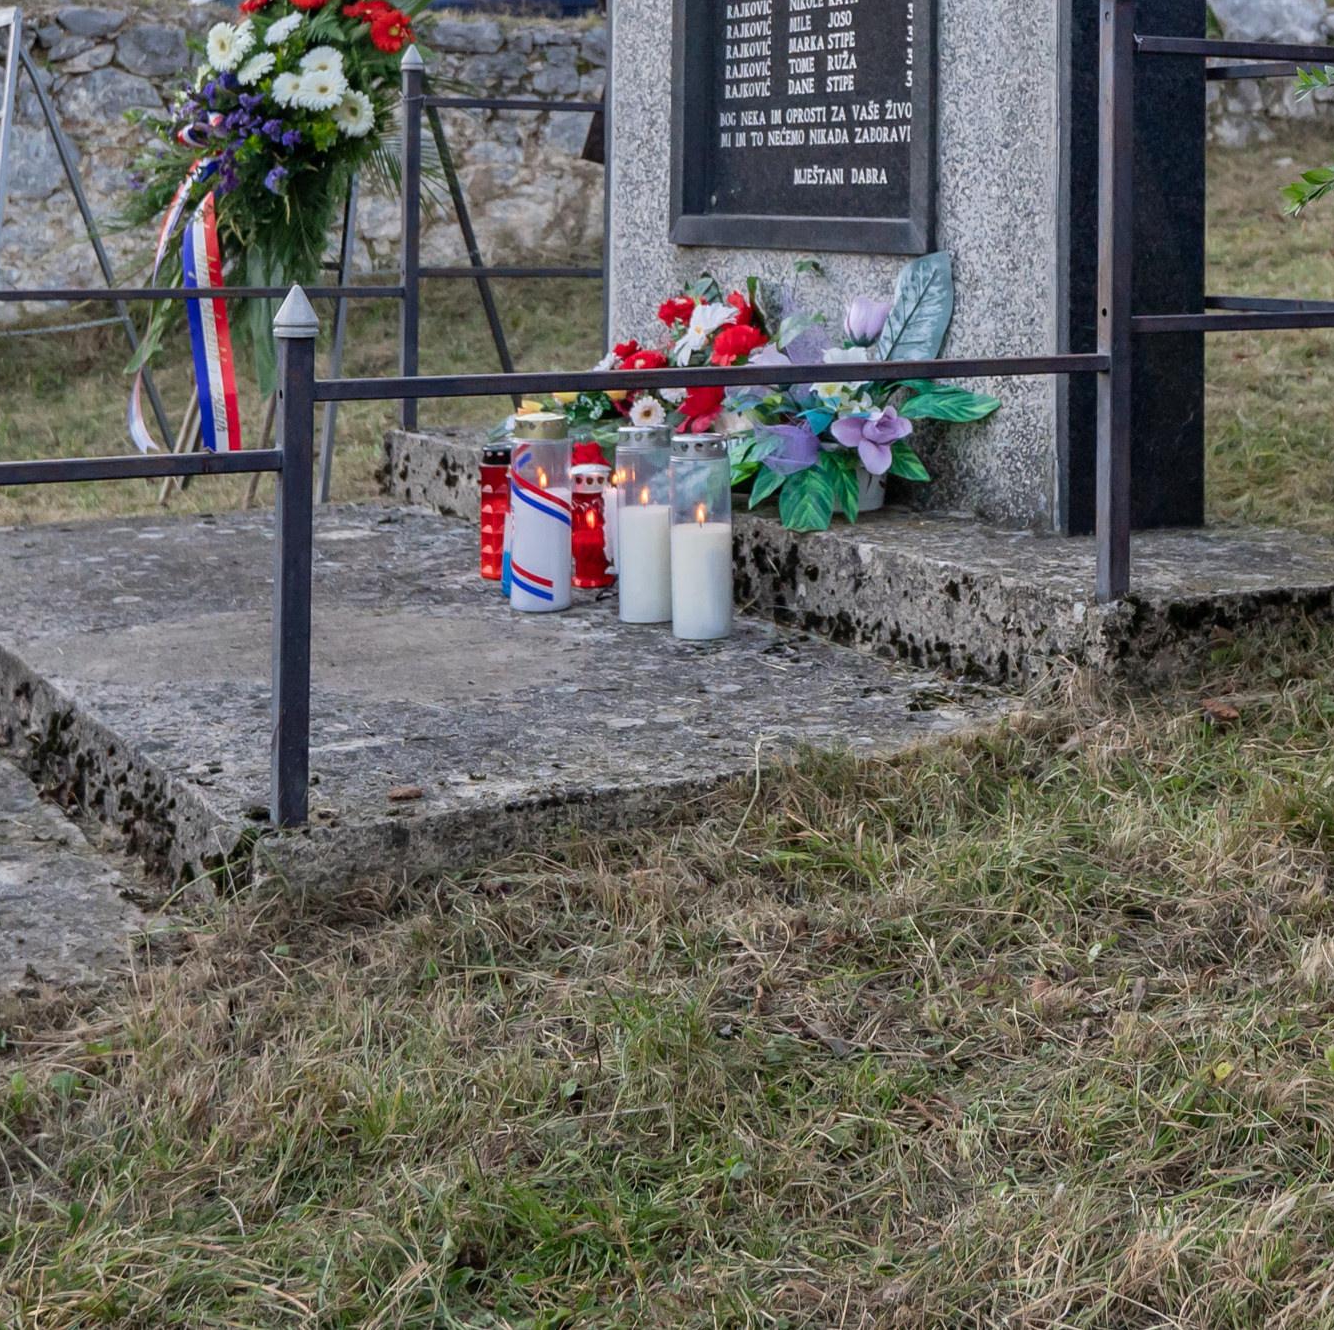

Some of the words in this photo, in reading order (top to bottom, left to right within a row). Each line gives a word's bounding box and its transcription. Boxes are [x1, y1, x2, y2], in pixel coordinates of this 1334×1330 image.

[726, 17, 771, 39] RAJKOVIĆ
[789, 15, 811, 33] MILE
[828, 11, 852, 28] JOSO
[726, 37, 771, 59] RAJKOVIĆ
[789, 35, 824, 54] MARKA
[828, 31, 855, 49] STIPE
[726, 57, 771, 79] RAJKOVIĆ
[789, 57, 815, 74] TOME
[827, 51, 856, 71] RUŽA
[725, 77, 770, 99] RAJKOVIĆ
[788, 78, 814, 94] DANE
[827, 75, 854, 92] STIPE
[720, 113, 736, 126] BOG
[741, 111, 765, 126] NEKA
[771, 109, 781, 124] IM
[786, 107, 826, 124] OPROSTI
[831, 107, 846, 121] ZA
[853, 101, 879, 121] VAŠE
[721, 133, 731, 147] MI
[736, 132, 746, 147] IM
[751, 132, 763, 146] TO
[768, 127, 804, 146] NEĆEMO
[810, 129, 849, 145] NIKADA
[794, 165, 843, 185] MJEŠTANI
[851, 168, 887, 184] DABRA
